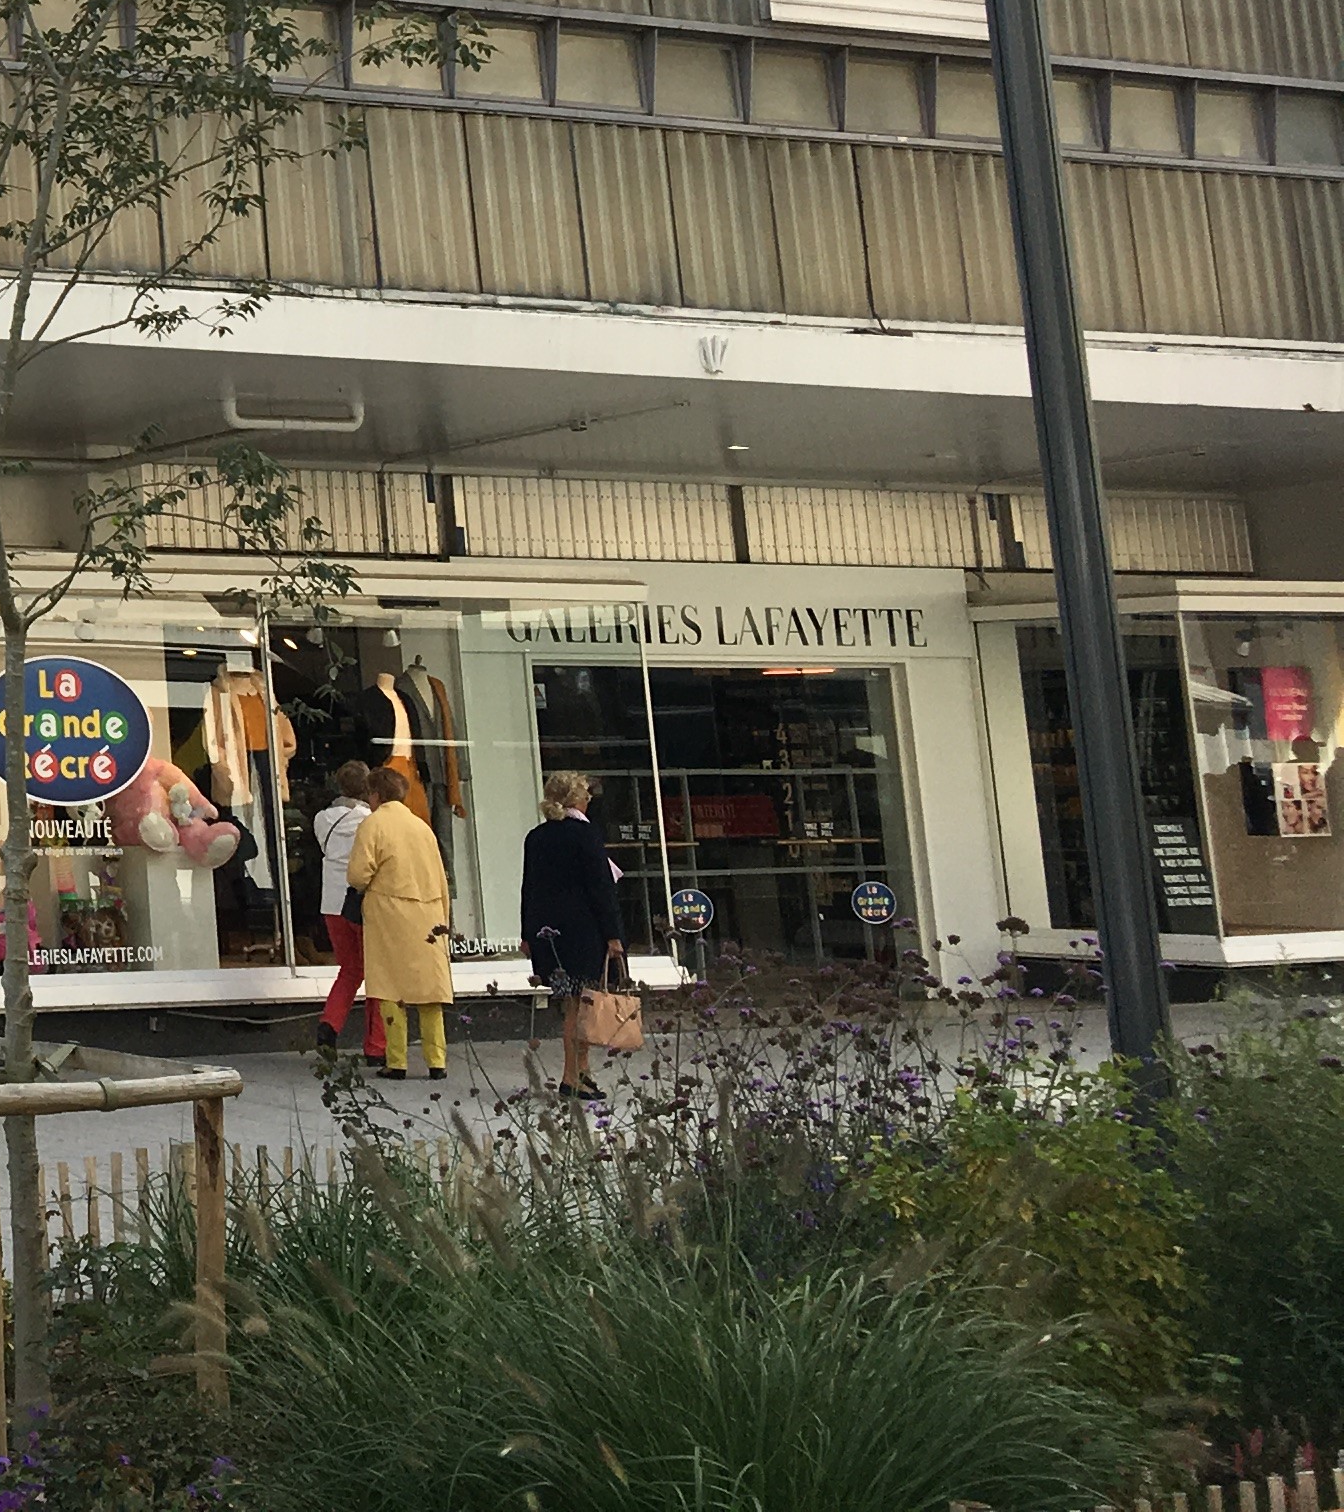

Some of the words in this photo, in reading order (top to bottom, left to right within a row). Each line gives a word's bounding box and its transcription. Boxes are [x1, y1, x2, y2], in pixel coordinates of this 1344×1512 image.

[505, 604, 702, 646] GALERIES
[715, 606, 929, 648] LAFAYETTE
[37, 669, 77, 699] La
[27, 945, 164, 966] LERIESLAFAYETTE.COM
